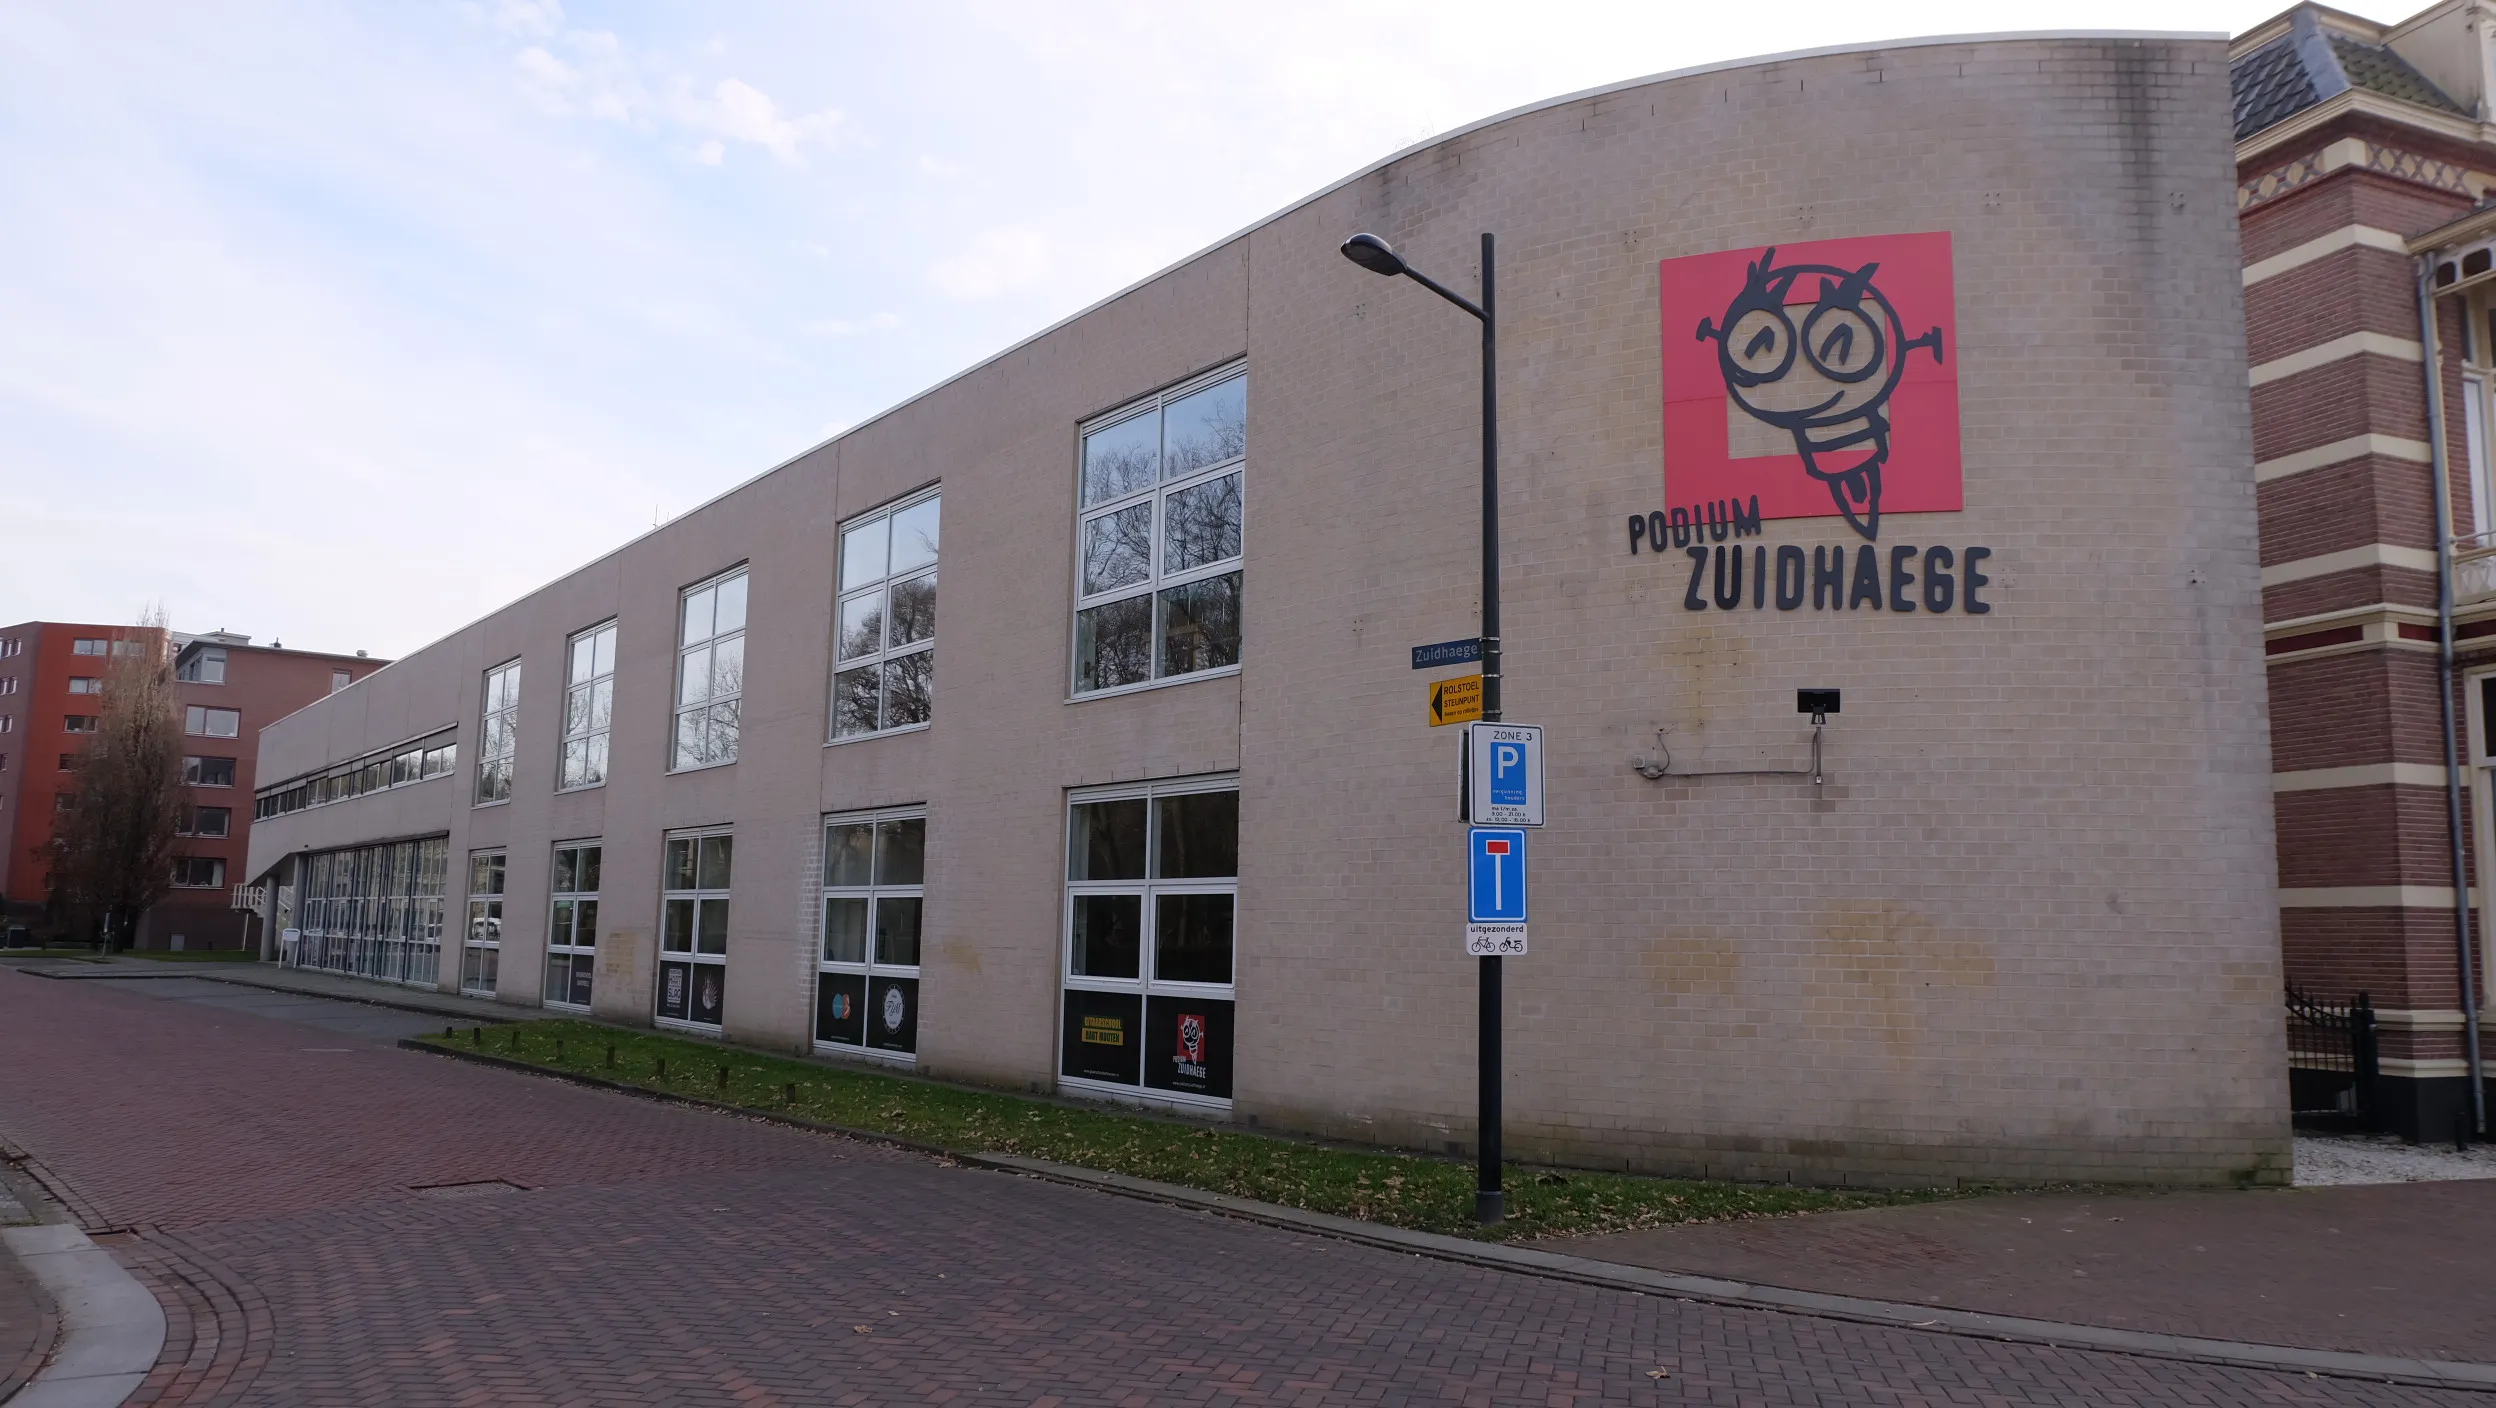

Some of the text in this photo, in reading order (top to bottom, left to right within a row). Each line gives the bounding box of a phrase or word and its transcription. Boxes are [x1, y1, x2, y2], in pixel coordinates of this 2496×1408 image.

[1628, 495, 1762, 555] PODIUM
[1684, 544, 1991, 614] ZUIDHAEGE
[1415, 644, 1478, 662] Zuidhaege
[1443, 681, 1479, 695] ROLSTOEL
[1443, 694, 1479, 708] STEUNPUNT
[1493, 731, 1533, 741] ZONE 3
[1498, 746, 1519, 779] P
[1470, 924, 1524, 935] uitgezonderd
[1177, 1063, 1206, 1079] ZUIDHAEGE
